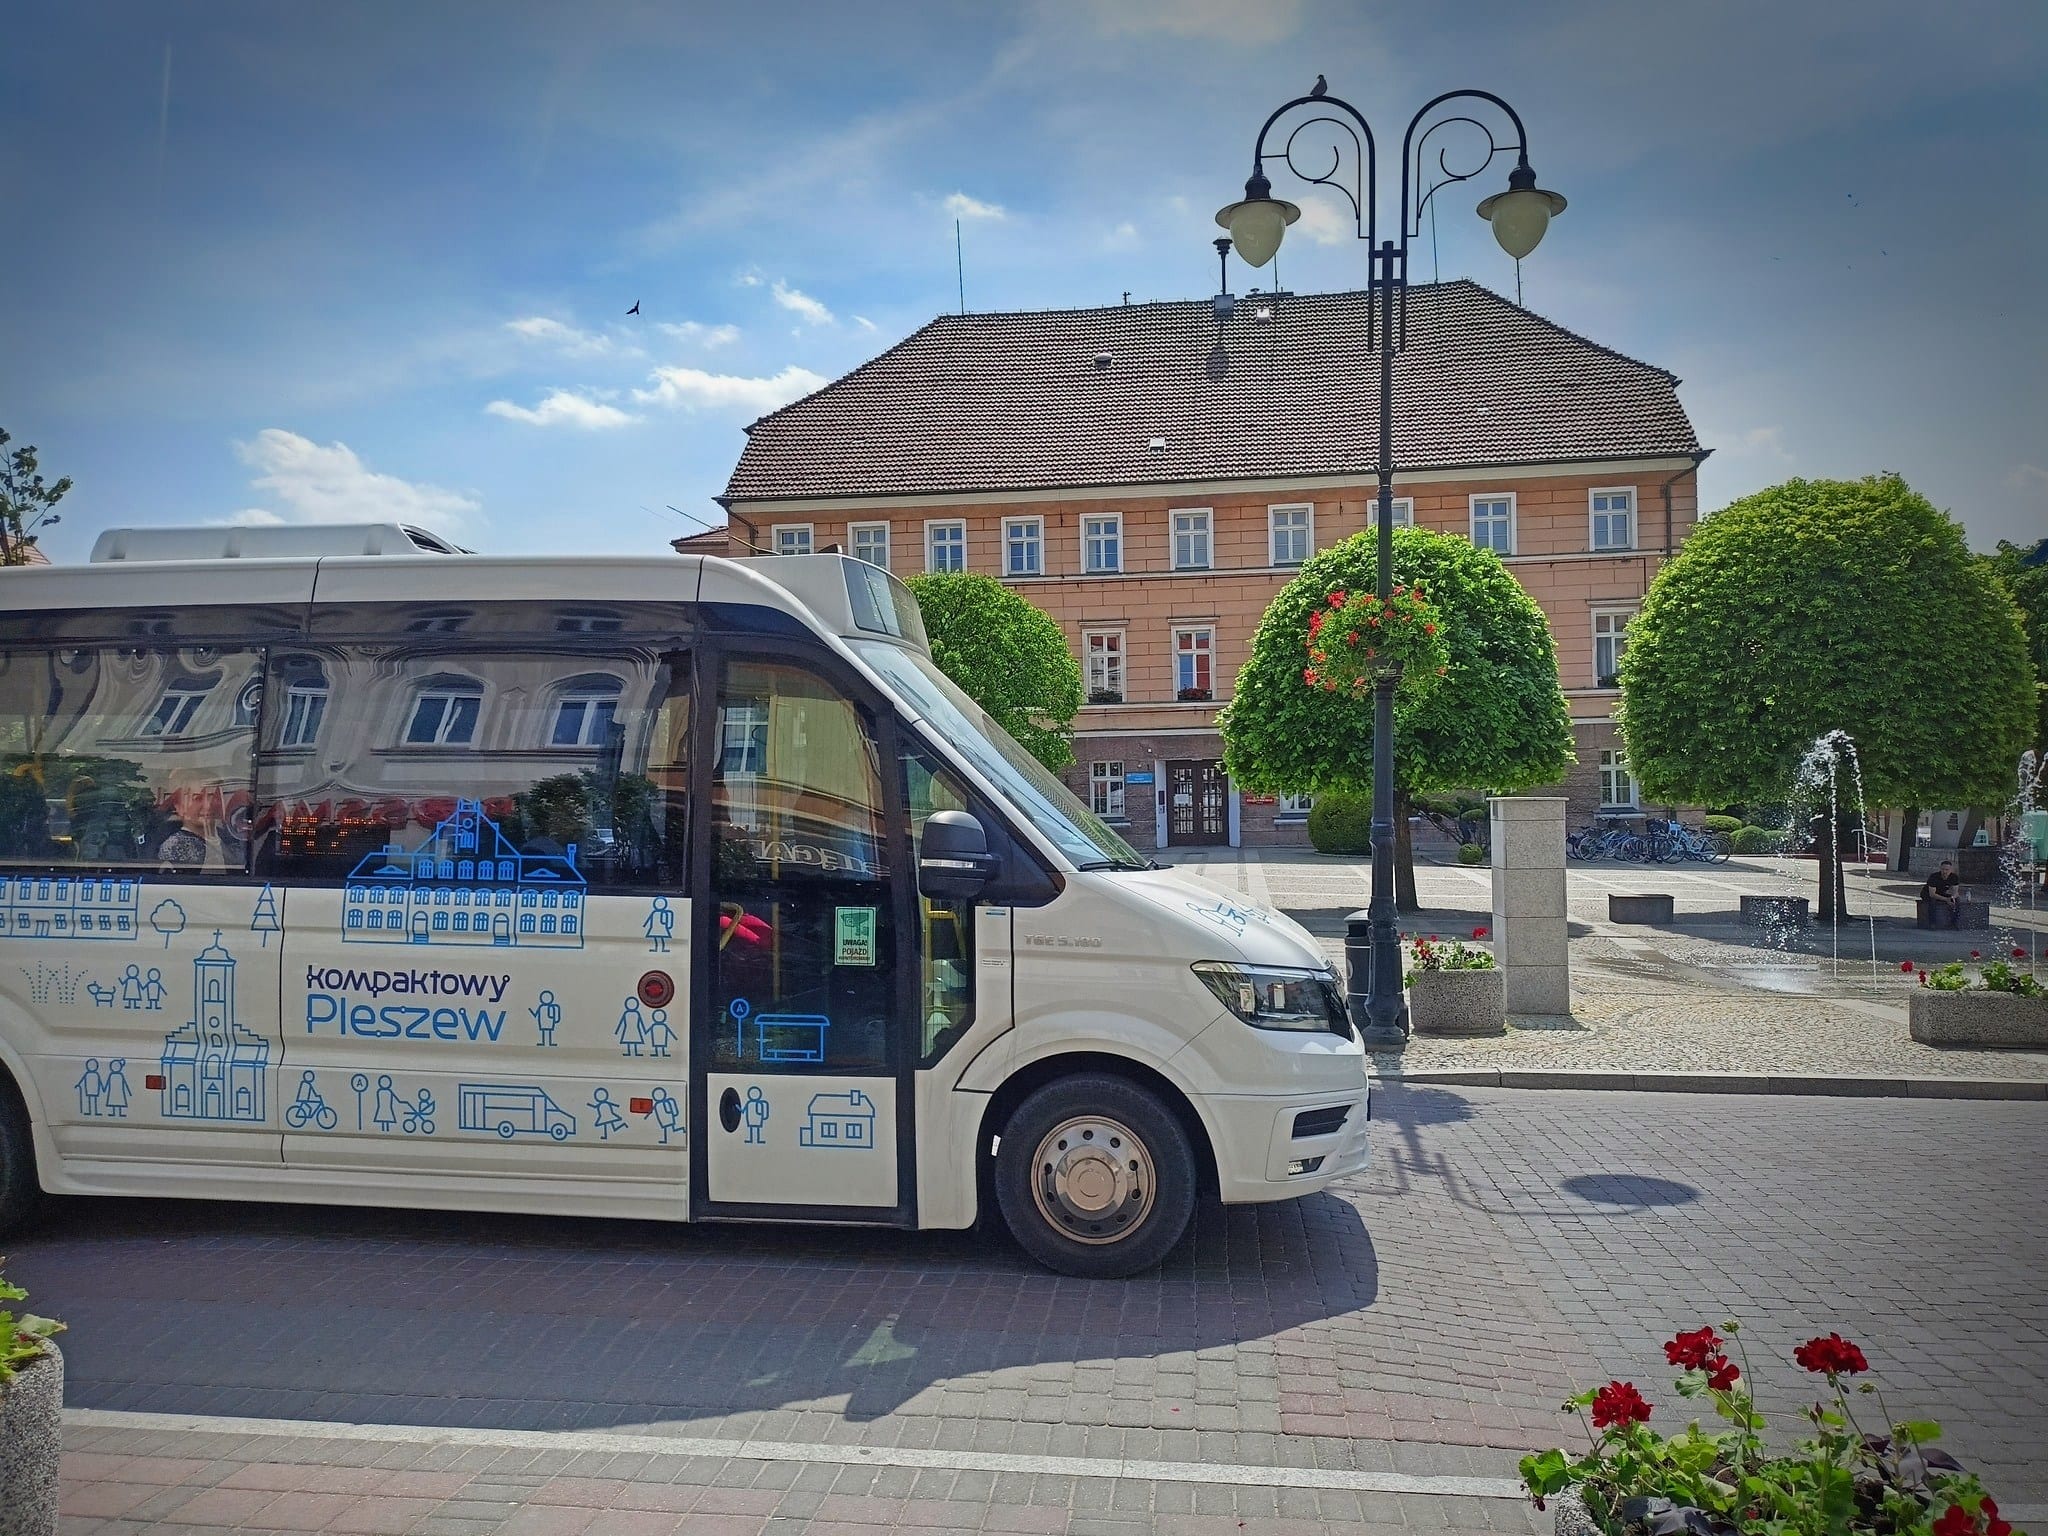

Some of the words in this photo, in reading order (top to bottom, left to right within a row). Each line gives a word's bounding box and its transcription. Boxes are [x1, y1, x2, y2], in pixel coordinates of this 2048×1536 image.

[1024, 935, 1054, 946] TGE
[307, 964, 510, 1002] kompaktowy
[306, 994, 507, 1041] Pleszew
[356, 1078, 363, 1088] A
